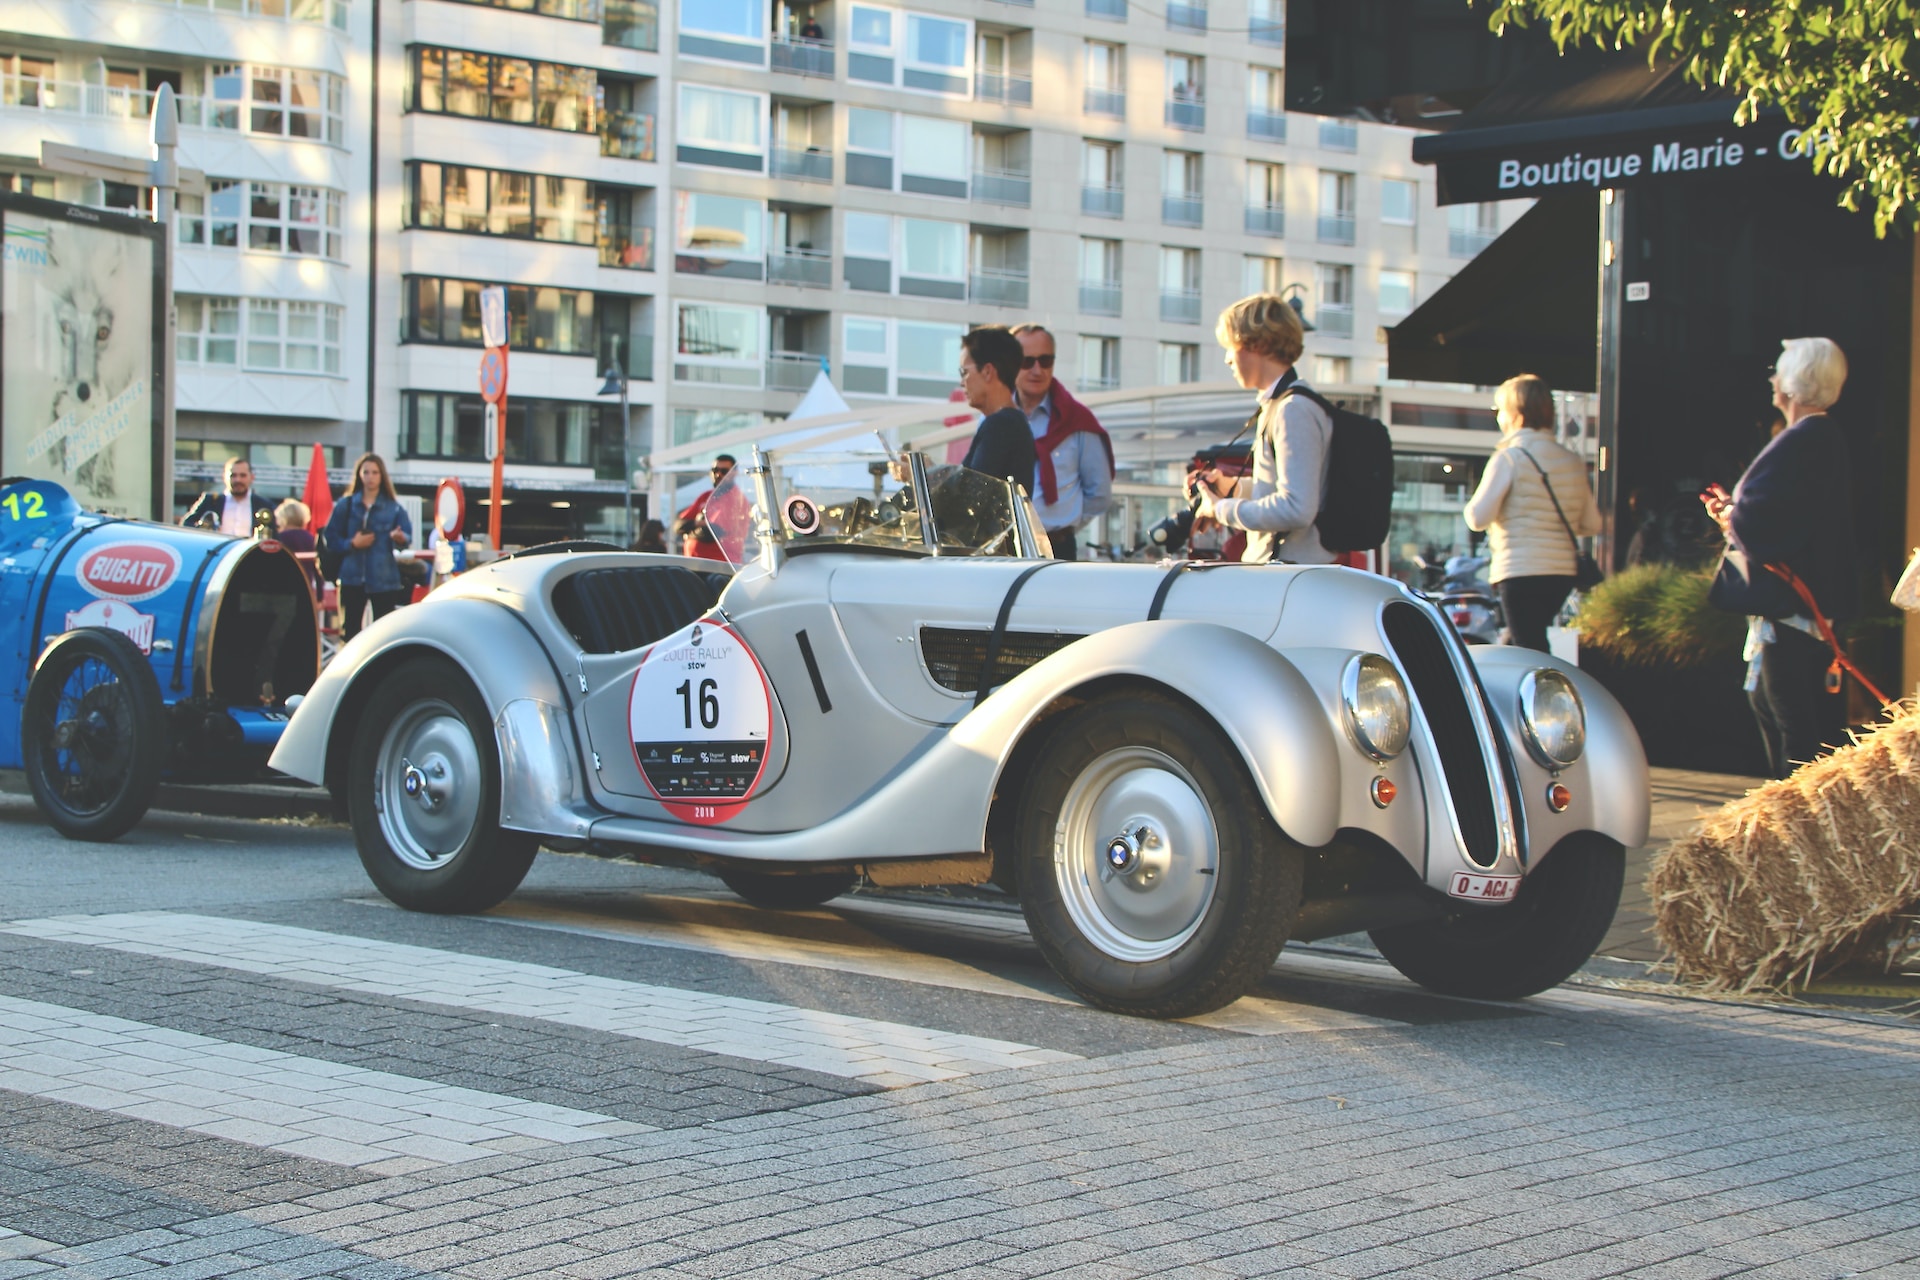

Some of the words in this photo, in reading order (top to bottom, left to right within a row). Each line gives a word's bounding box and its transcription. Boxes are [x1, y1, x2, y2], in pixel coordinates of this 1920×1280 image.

[1498, 153, 1642, 188] Boutique
[1652, 137, 1744, 173] Marie
[4, 244, 48, 266] ZWIN
[66, 381, 144, 447] PHOTOGRAPHER
[27, 412, 76, 458] WILDLIFE
[65, 450, 78, 472] OF
[82, 434, 101, 456] THE
[104, 413, 129, 441] YEAR
[2, 491, 48, 521] 12
[88, 555, 167, 588] BUGATTI
[663, 648, 696, 662] ZOUTE
[687, 661, 706, 670] stow
[676, 678, 720, 729] 16
[672, 754, 682, 764] EY
[731, 754, 751, 764] stow
[695, 806, 715, 818] 2018
